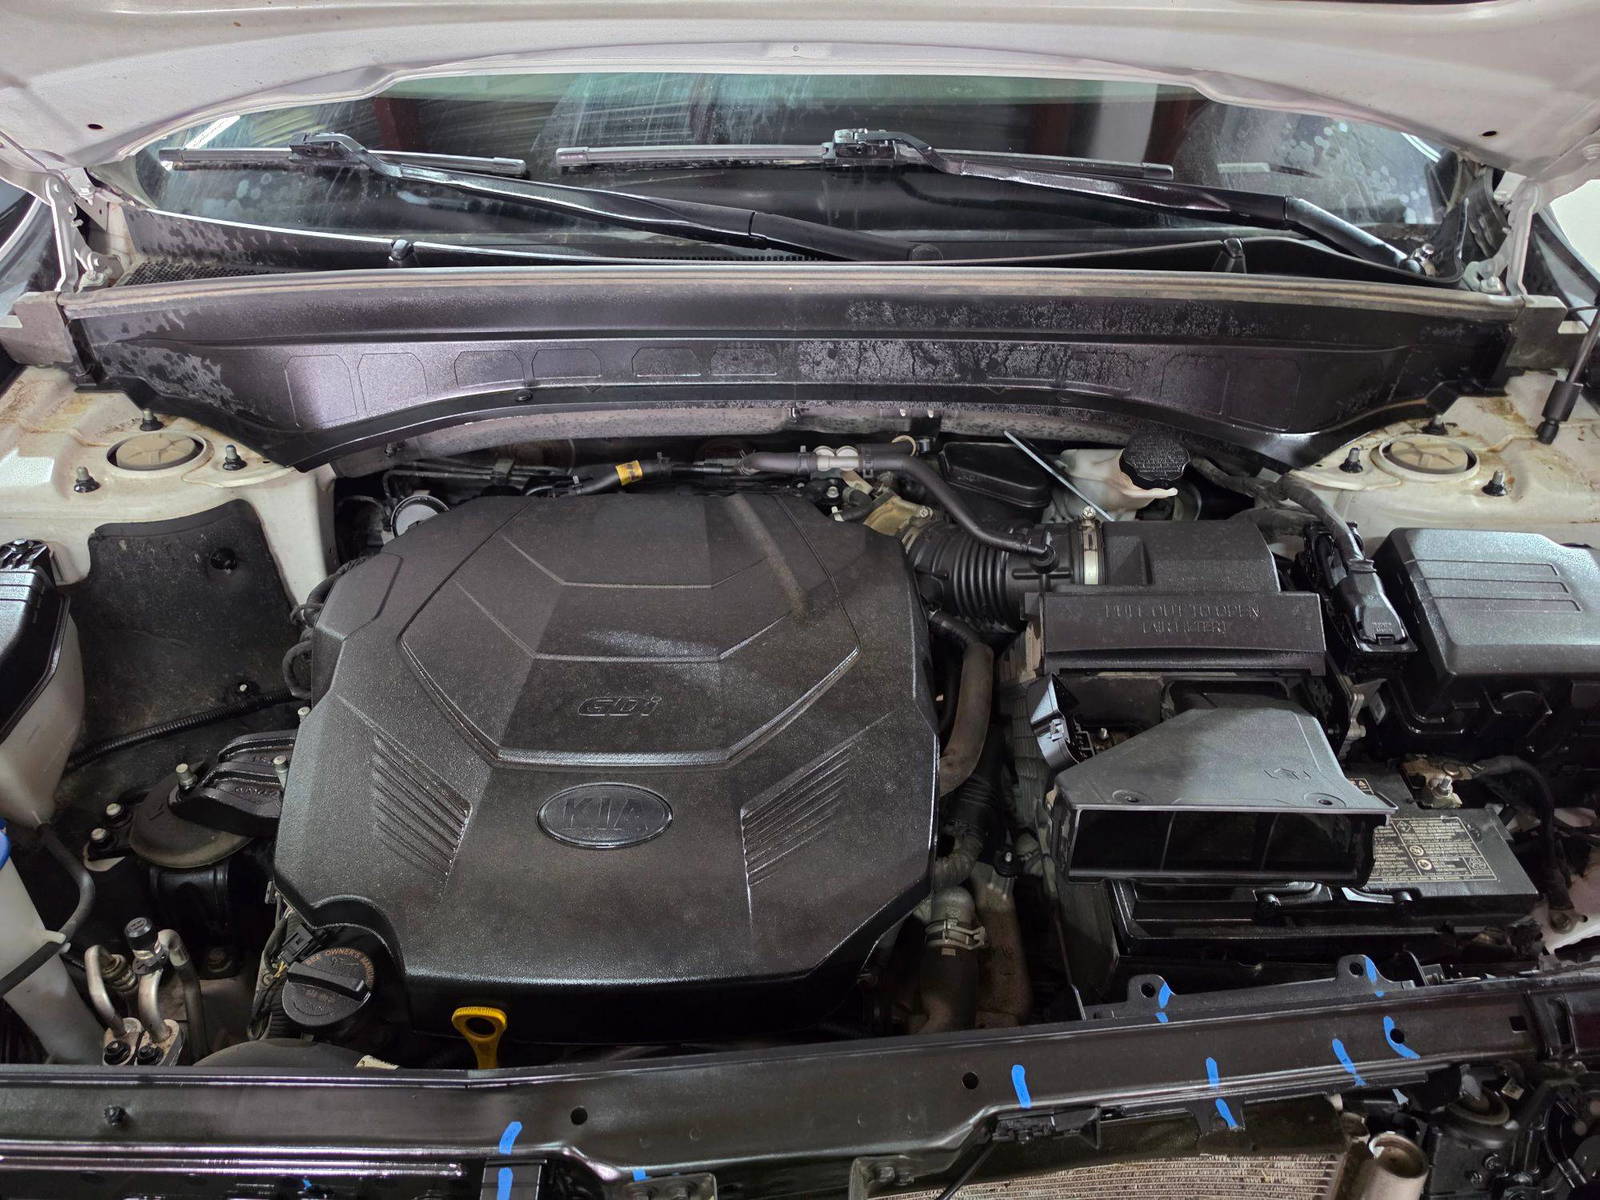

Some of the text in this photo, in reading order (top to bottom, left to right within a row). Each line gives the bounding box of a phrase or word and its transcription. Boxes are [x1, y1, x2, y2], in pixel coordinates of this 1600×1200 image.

[1150, 603, 1184, 618] OUT
[1188, 603, 1211, 618] TO
[561, 796, 650, 831] KIA
